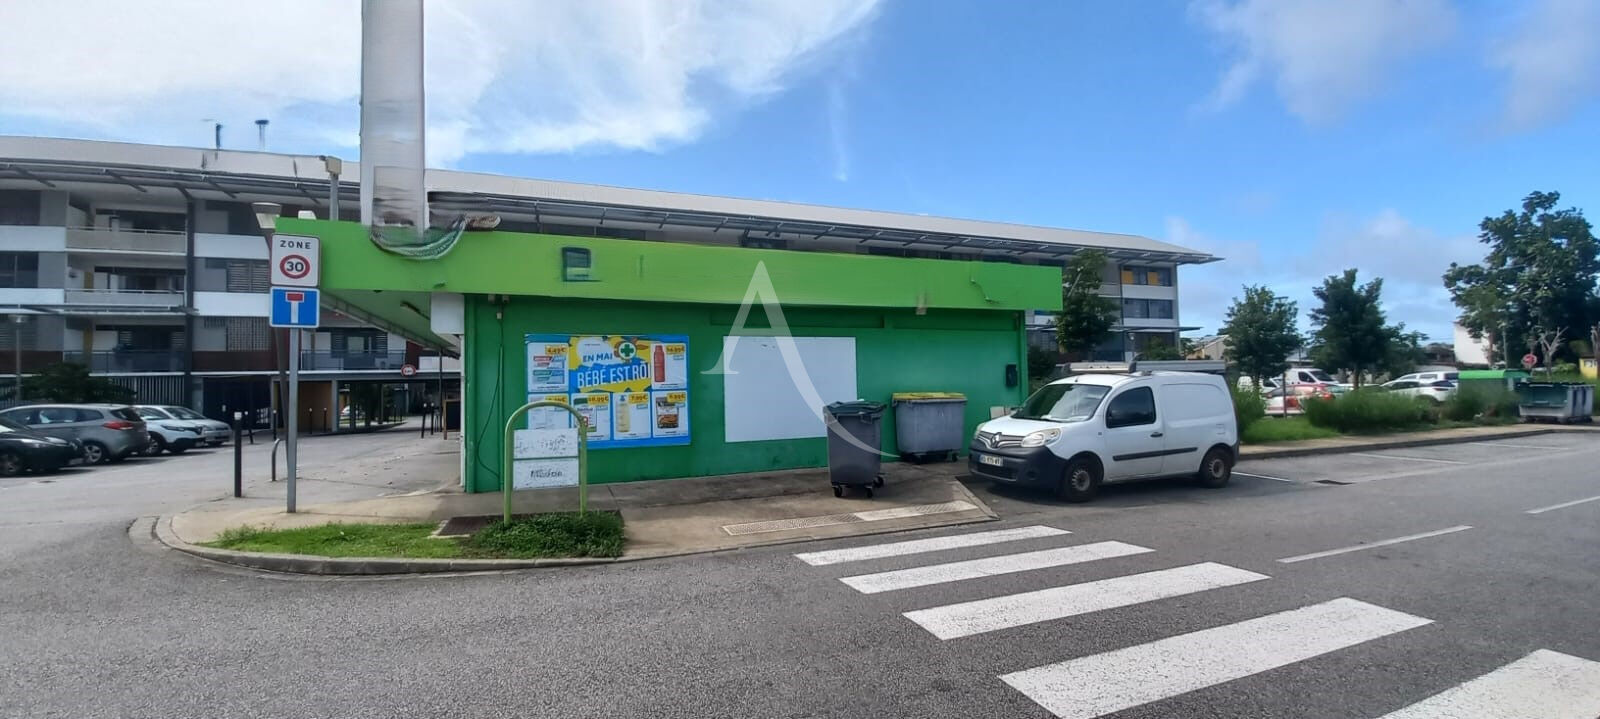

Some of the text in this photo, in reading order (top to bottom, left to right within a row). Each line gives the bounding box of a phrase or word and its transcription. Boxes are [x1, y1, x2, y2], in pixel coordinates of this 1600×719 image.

[280, 240, 312, 249] ZONE
[286, 261, 304, 273] 30
[582, 352, 613, 363] EN MAI
[577, 366, 607, 389] BÉBÉ
[610, 365, 630, 384] EST
